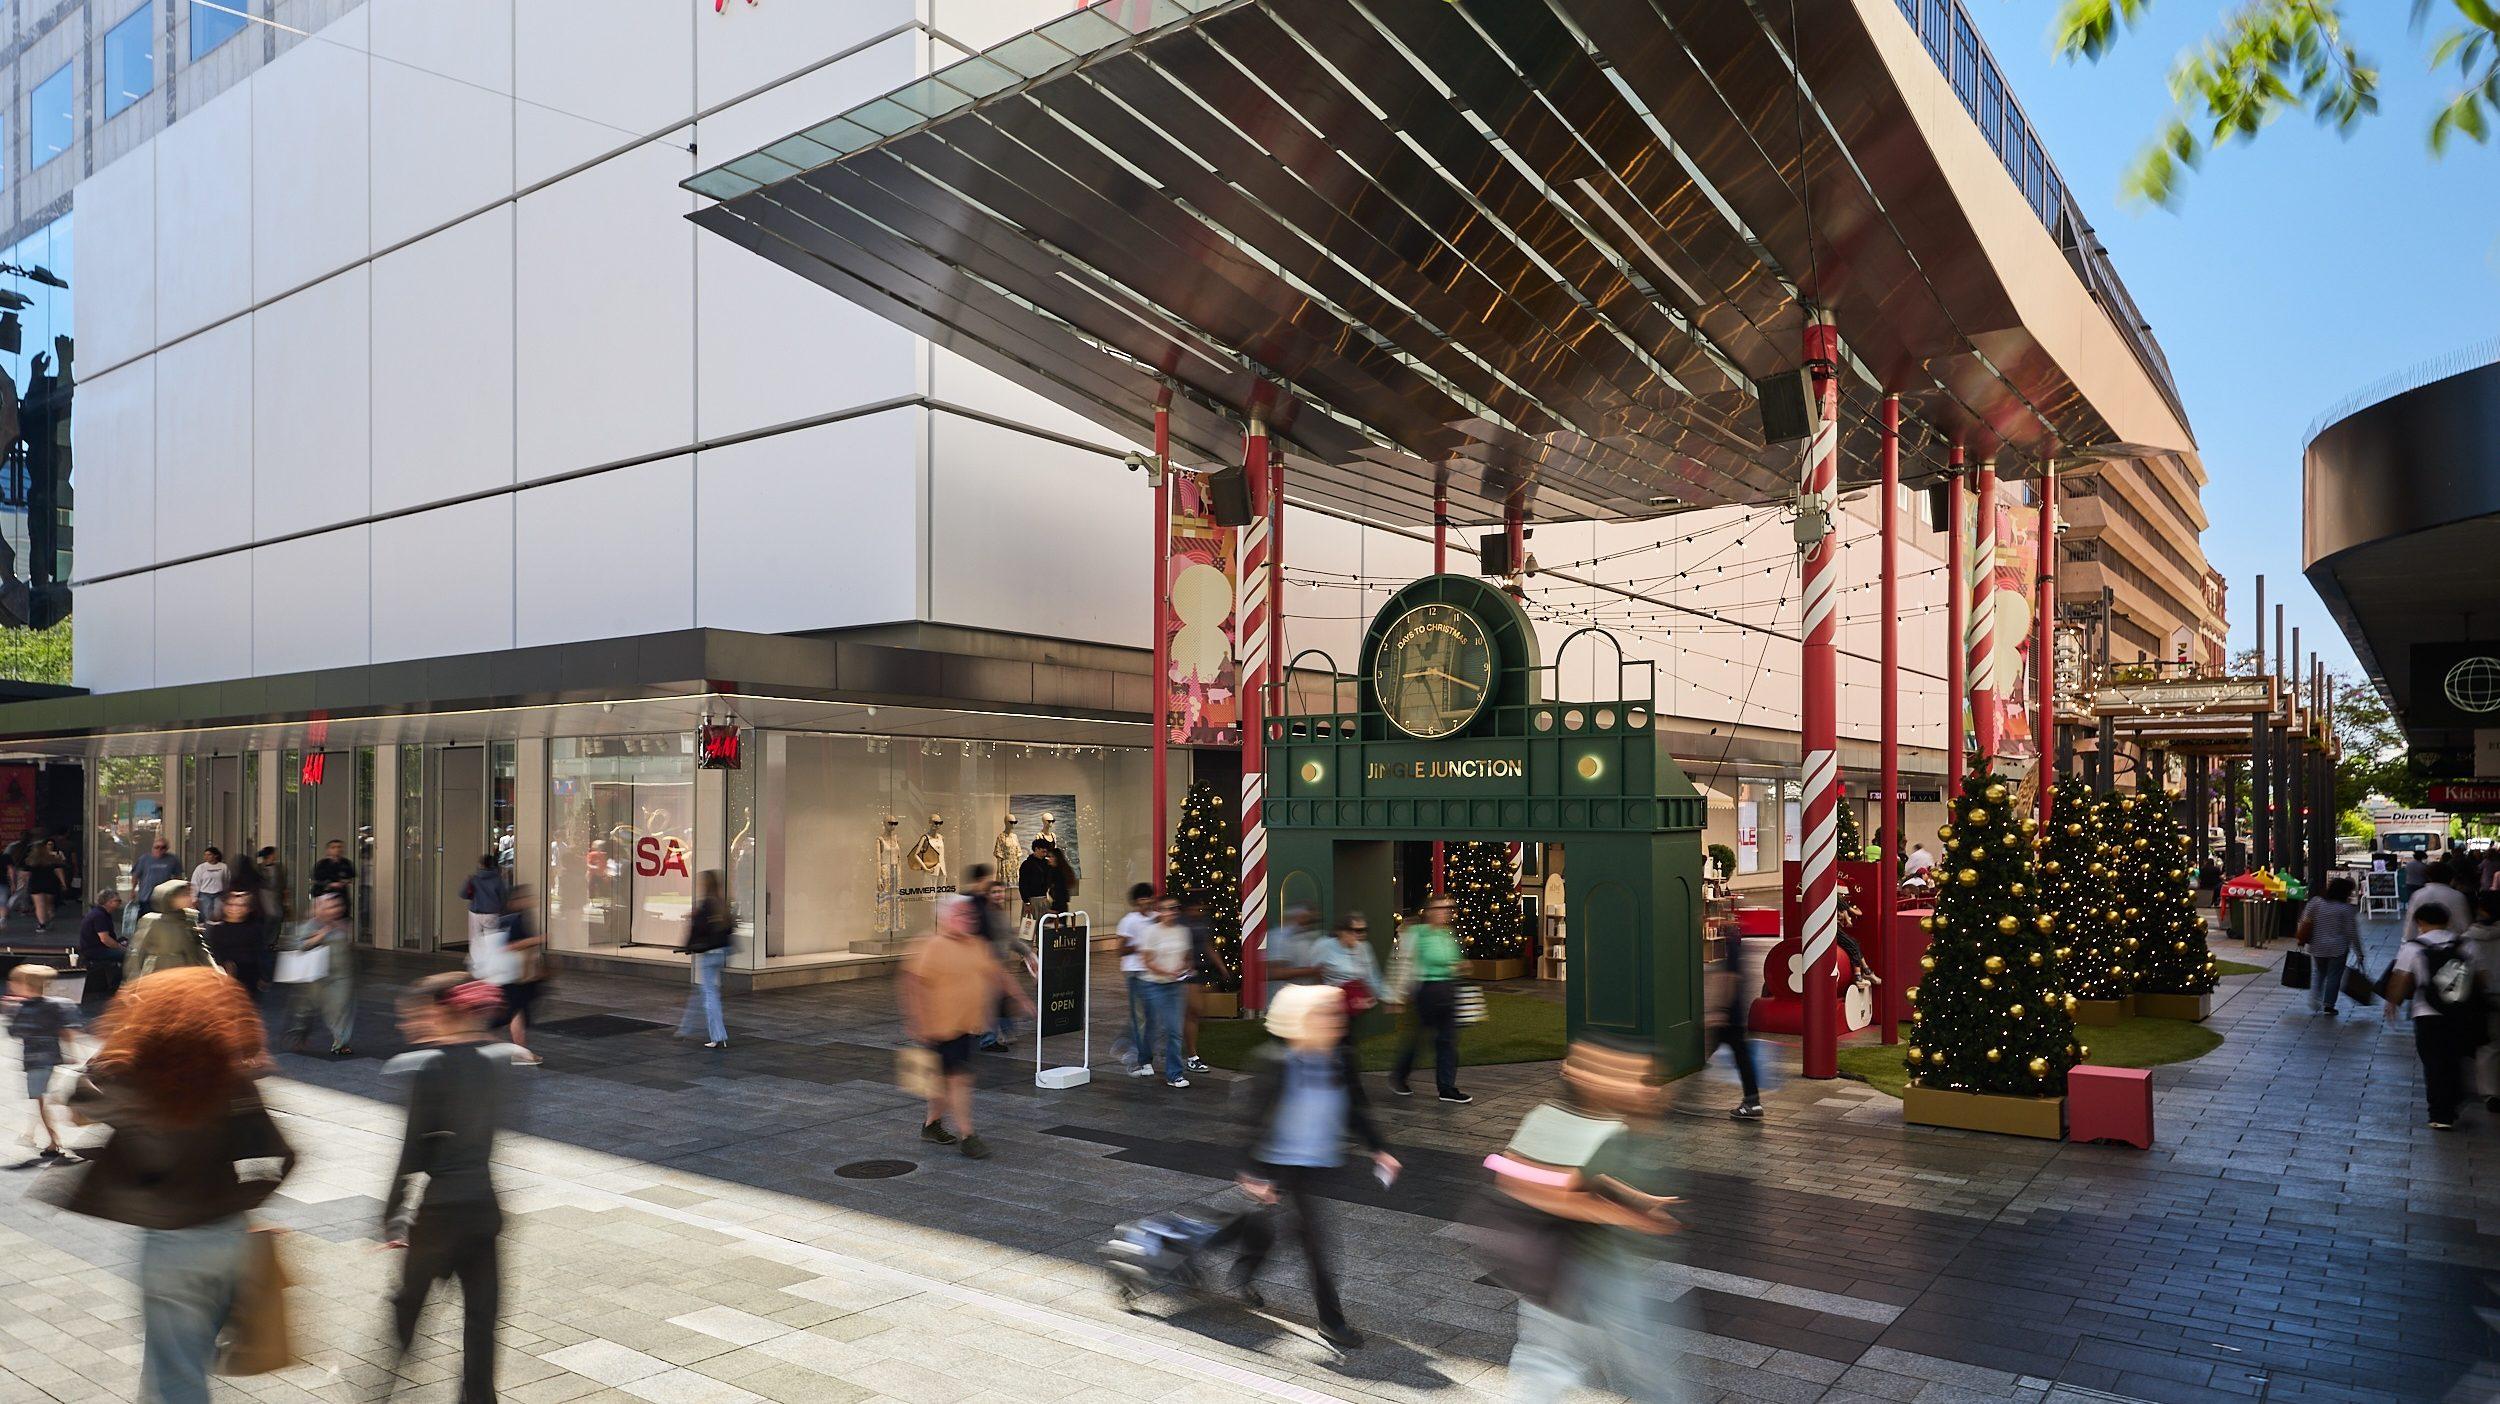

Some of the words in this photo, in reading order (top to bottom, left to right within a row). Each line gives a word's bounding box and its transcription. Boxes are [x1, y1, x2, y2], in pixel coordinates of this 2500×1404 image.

[1429, 607, 1437, 615] 12
[1453, 613, 1460, 621] 11
[1397, 631, 1415, 650] DAYS
[1414, 625, 1426, 635] TO
[1474, 638, 1483, 646] 10
[1383, 643, 1388, 651] 2
[1483, 663, 1489, 672] 9
[1382, 697, 1387, 705] 4
[1476, 693, 1482, 701] 8
[1405, 721, 1410, 729] 5
[1452, 720, 1458, 728] 7
[1428, 726, 1434, 735] 6
[900, 887, 936, 896] SUMMER
[1050, 998, 1075, 1012] OPEN
